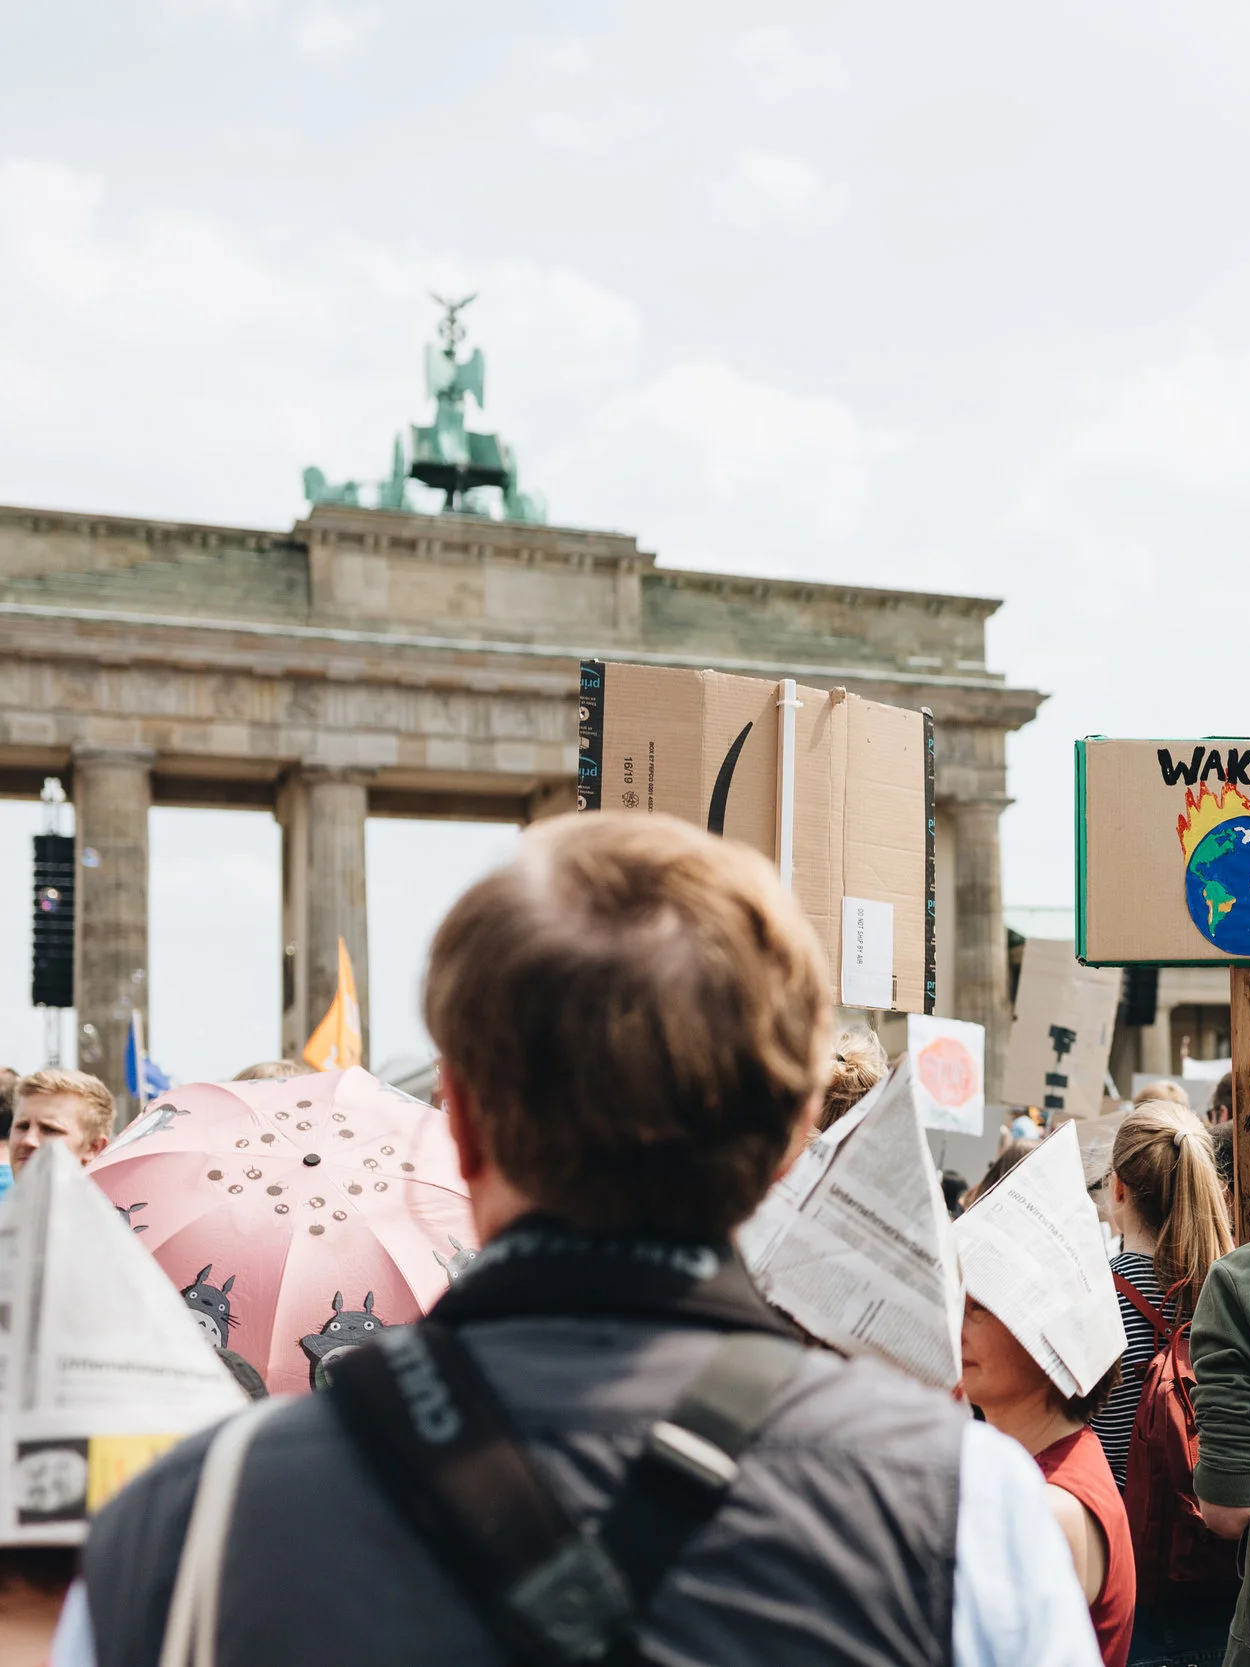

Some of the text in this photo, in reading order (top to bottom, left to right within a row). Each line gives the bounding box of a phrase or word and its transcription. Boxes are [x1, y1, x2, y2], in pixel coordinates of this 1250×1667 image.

[624, 757, 633, 784] 16/19
[857, 908, 864, 916] DO
[857, 945, 863, 953] BY
